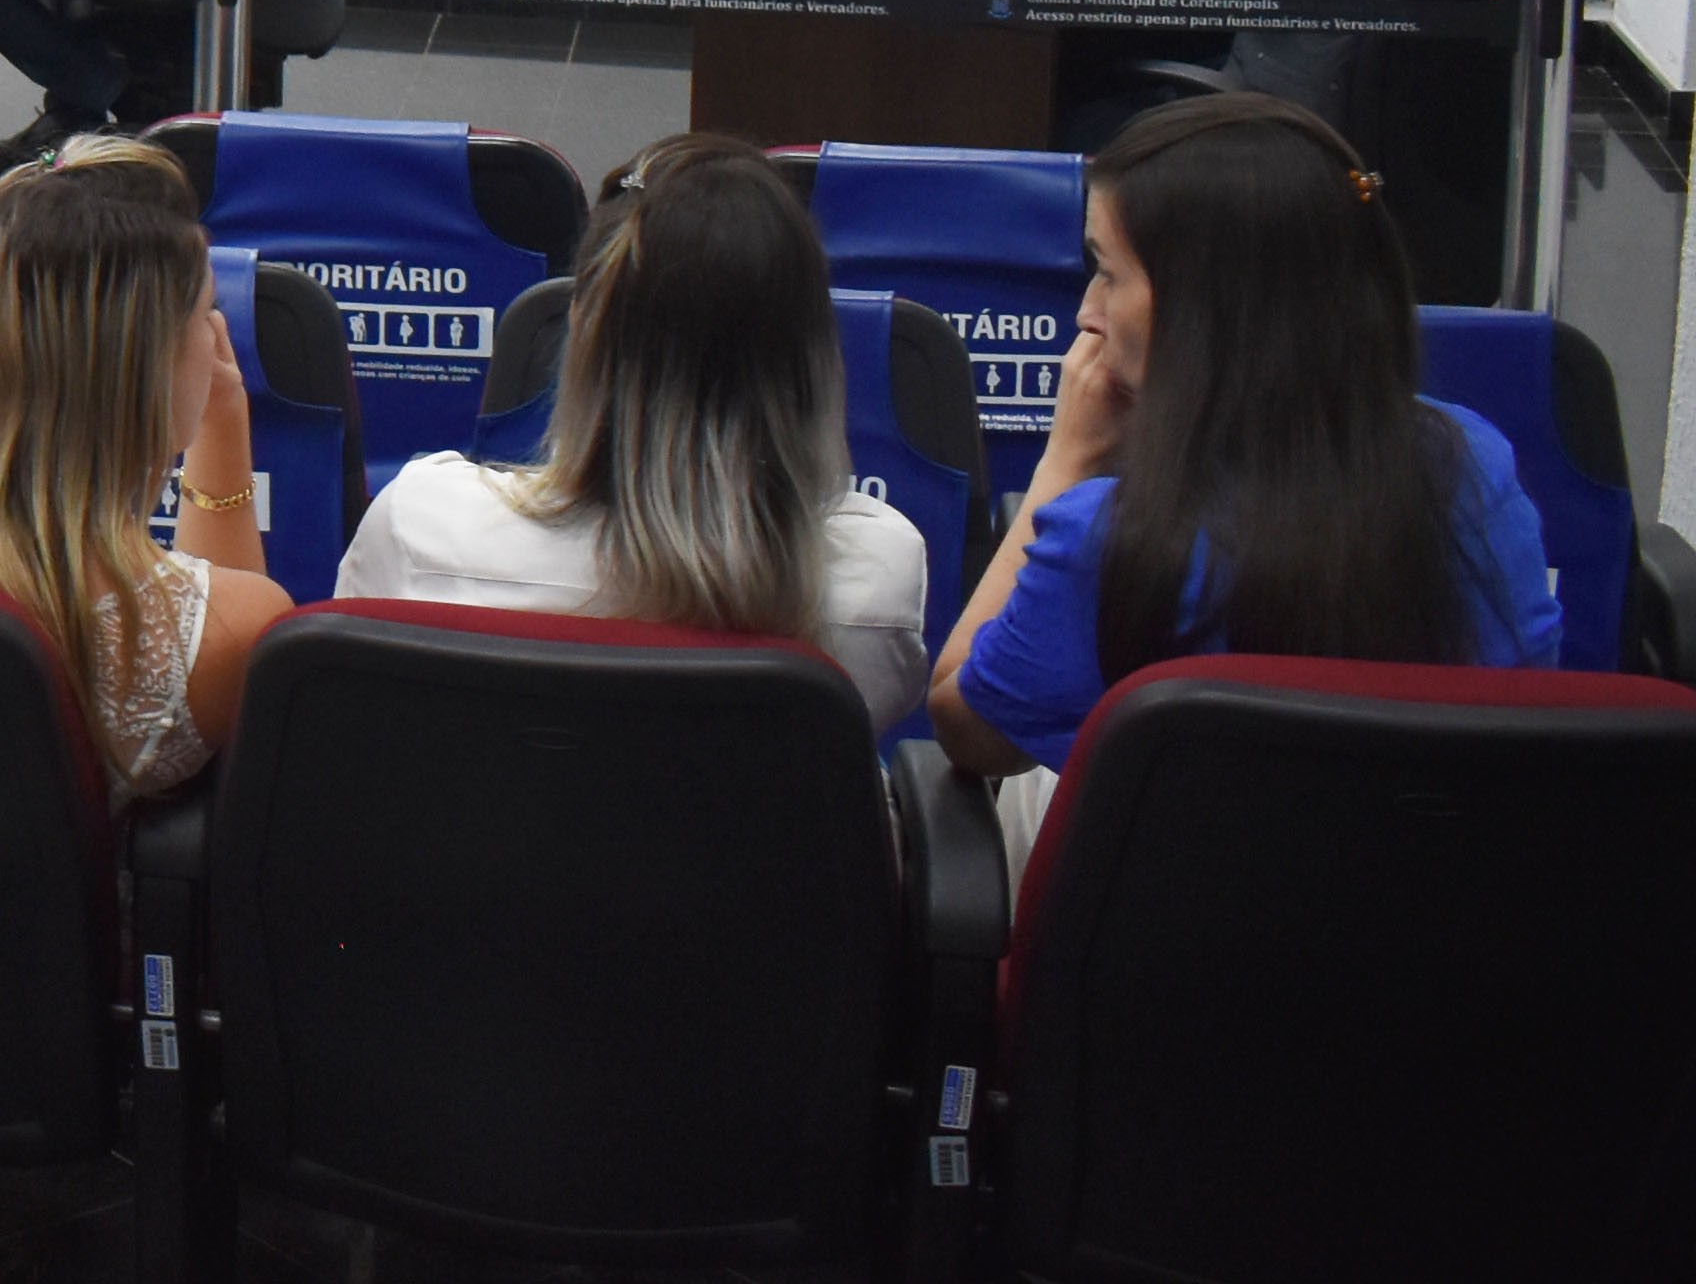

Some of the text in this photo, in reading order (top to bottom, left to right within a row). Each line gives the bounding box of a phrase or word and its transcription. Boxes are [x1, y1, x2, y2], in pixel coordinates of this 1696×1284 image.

[795, 3, 804, 12] e
[806, 0, 889, 16] Vereadores.
[1026, 9, 1421, 32] Acesso restrito apenas para funcionários e Vereadores.
[274, 261, 467, 294] ORITÁRIO
